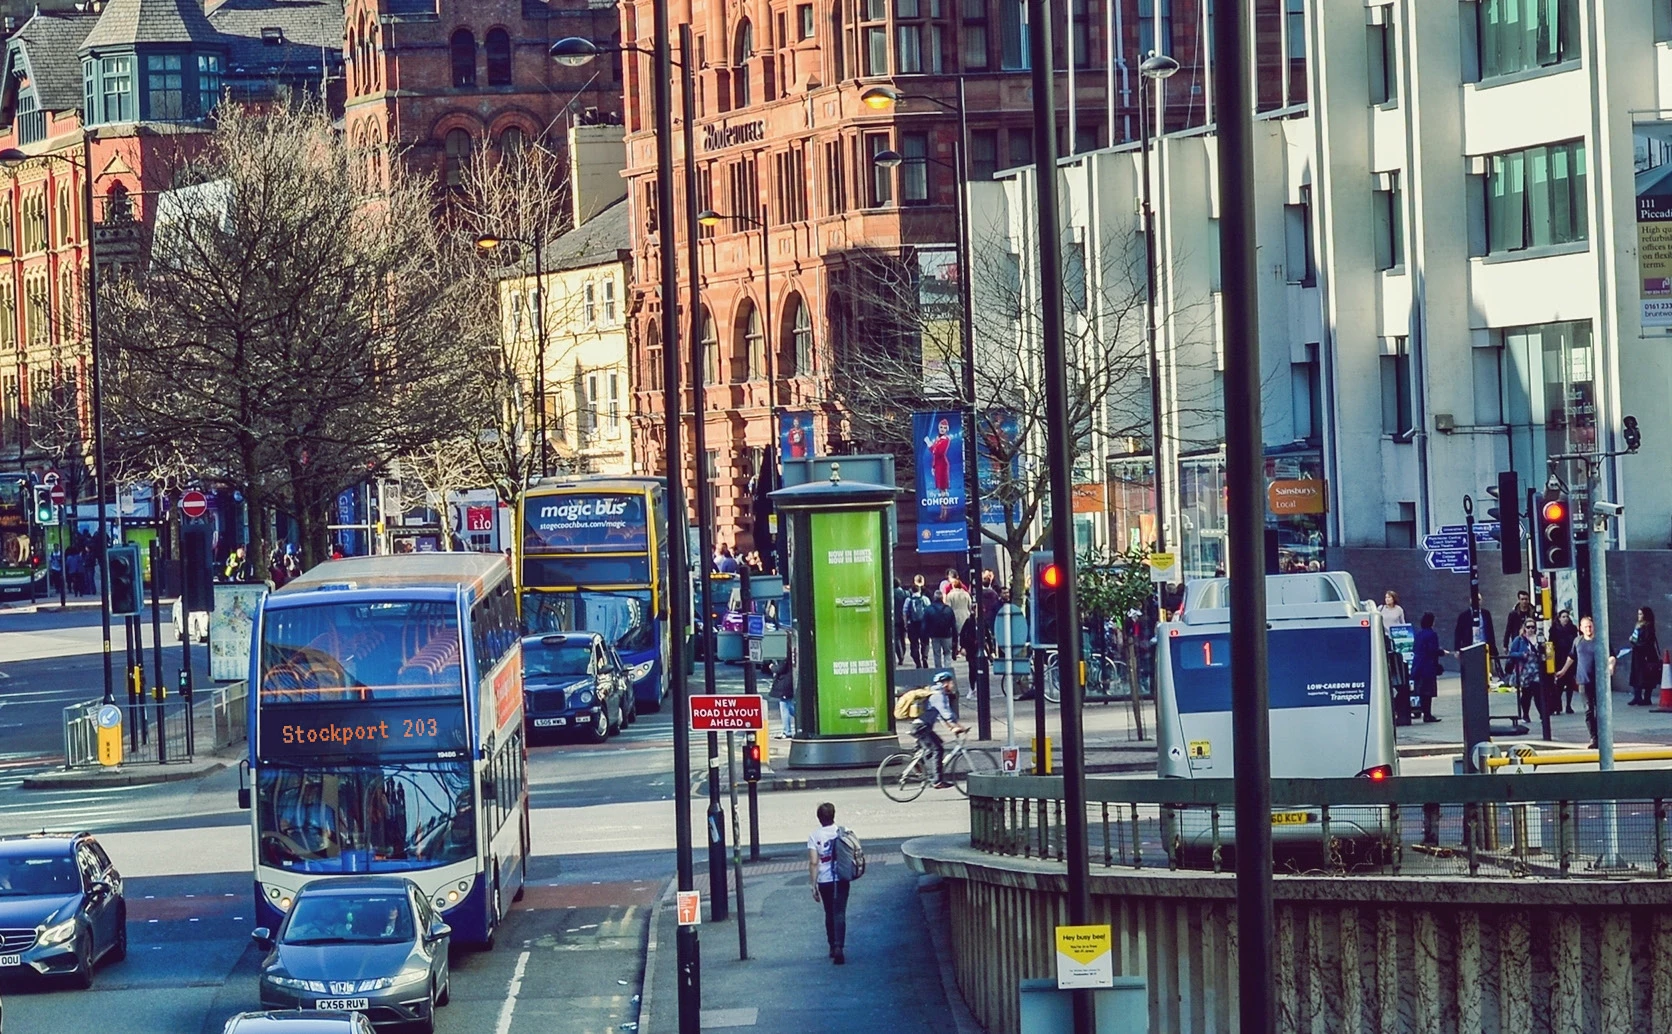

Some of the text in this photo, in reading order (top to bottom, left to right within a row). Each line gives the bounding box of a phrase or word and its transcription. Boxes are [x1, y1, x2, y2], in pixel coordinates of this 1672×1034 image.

[1642, 226, 1660, 234] High
[1275, 487, 1318, 496] Sainsbury's
[921, 497, 959, 506] COMFORT
[1276, 500, 1297, 508] Local
[540, 499, 625, 521] magic bus
[473, 520, 492, 530] £10
[1203, 641, 1212, 666] 1
[1330, 694, 1364, 702] Transport
[715, 699, 737, 707] NEW
[693, 709, 759, 717] ROAD LAYOUT
[710, 719, 743, 727] AHEAD
[282, 718, 438, 745] Stockport 203
[320, 999, 365, 1010] CX56 RUV
